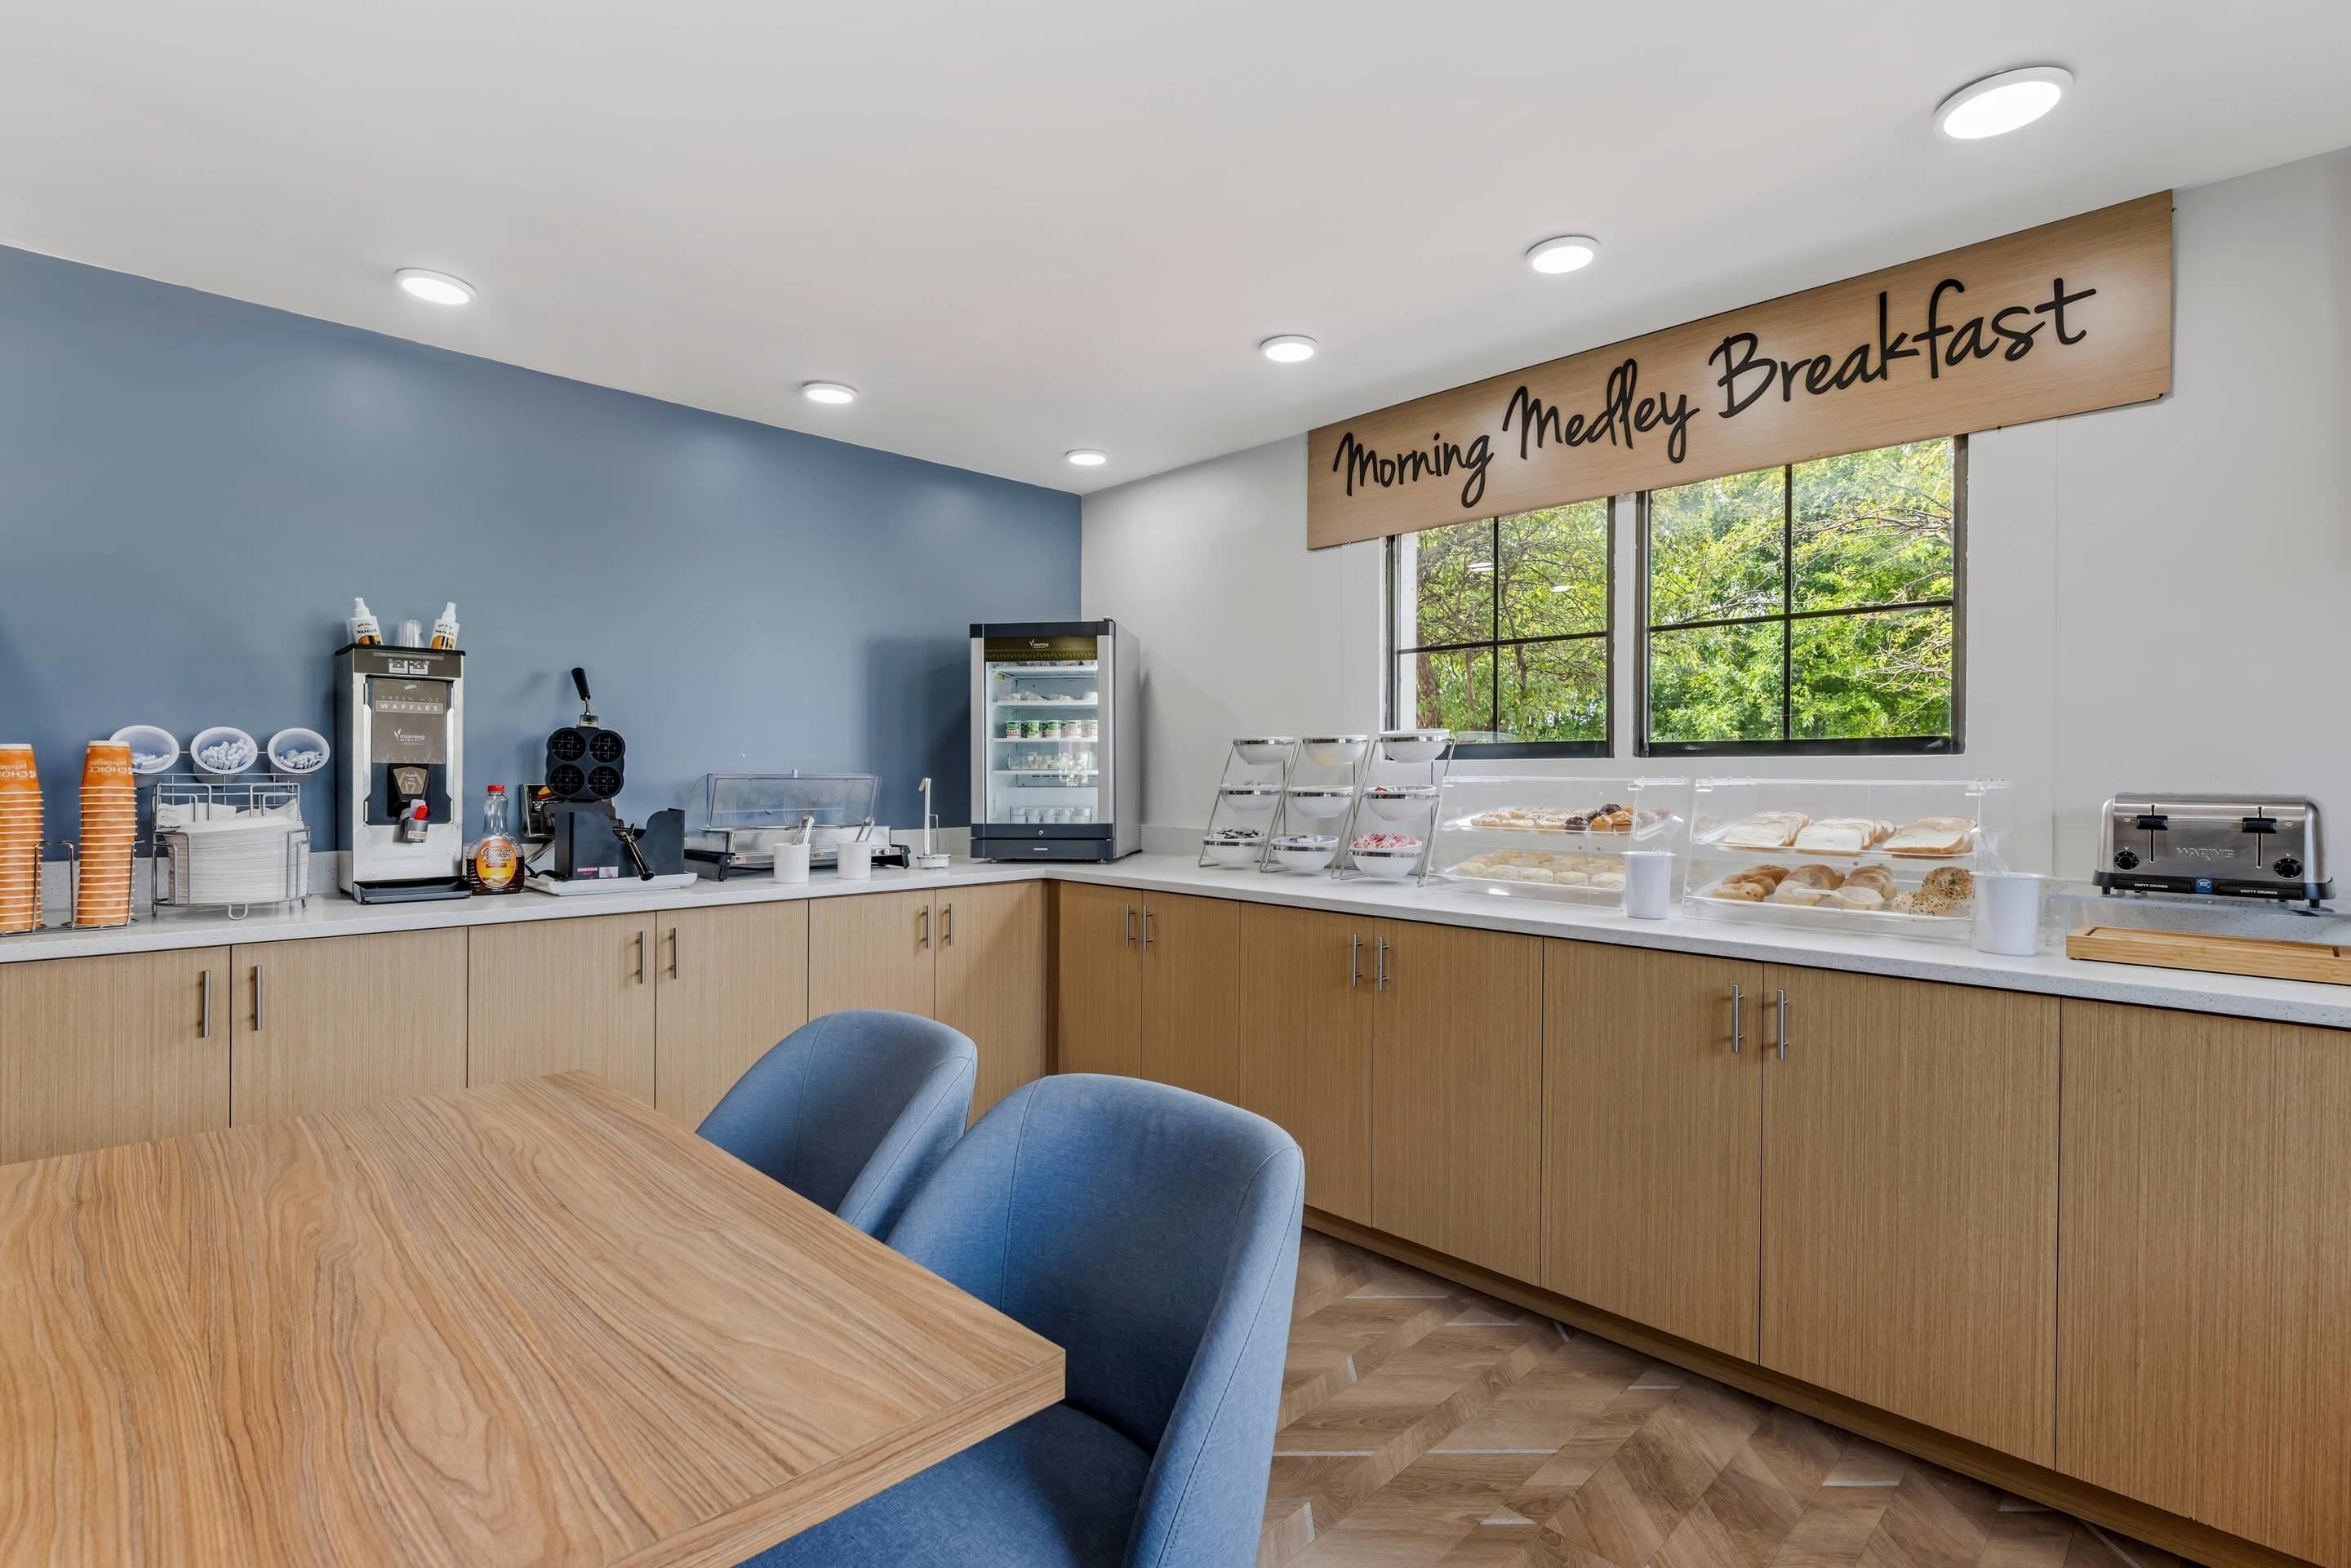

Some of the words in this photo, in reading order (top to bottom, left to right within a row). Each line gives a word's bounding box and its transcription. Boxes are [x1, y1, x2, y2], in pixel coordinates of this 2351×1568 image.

[1332, 432, 1495, 509] Morning
[1501, 358, 1700, 464] Medley
[1708, 277, 2097, 419] Breakfast
[380, 703, 438, 711] WAFFLES
[481, 846, 512, 856] Country
[2176, 847, 2234, 861] WARING
